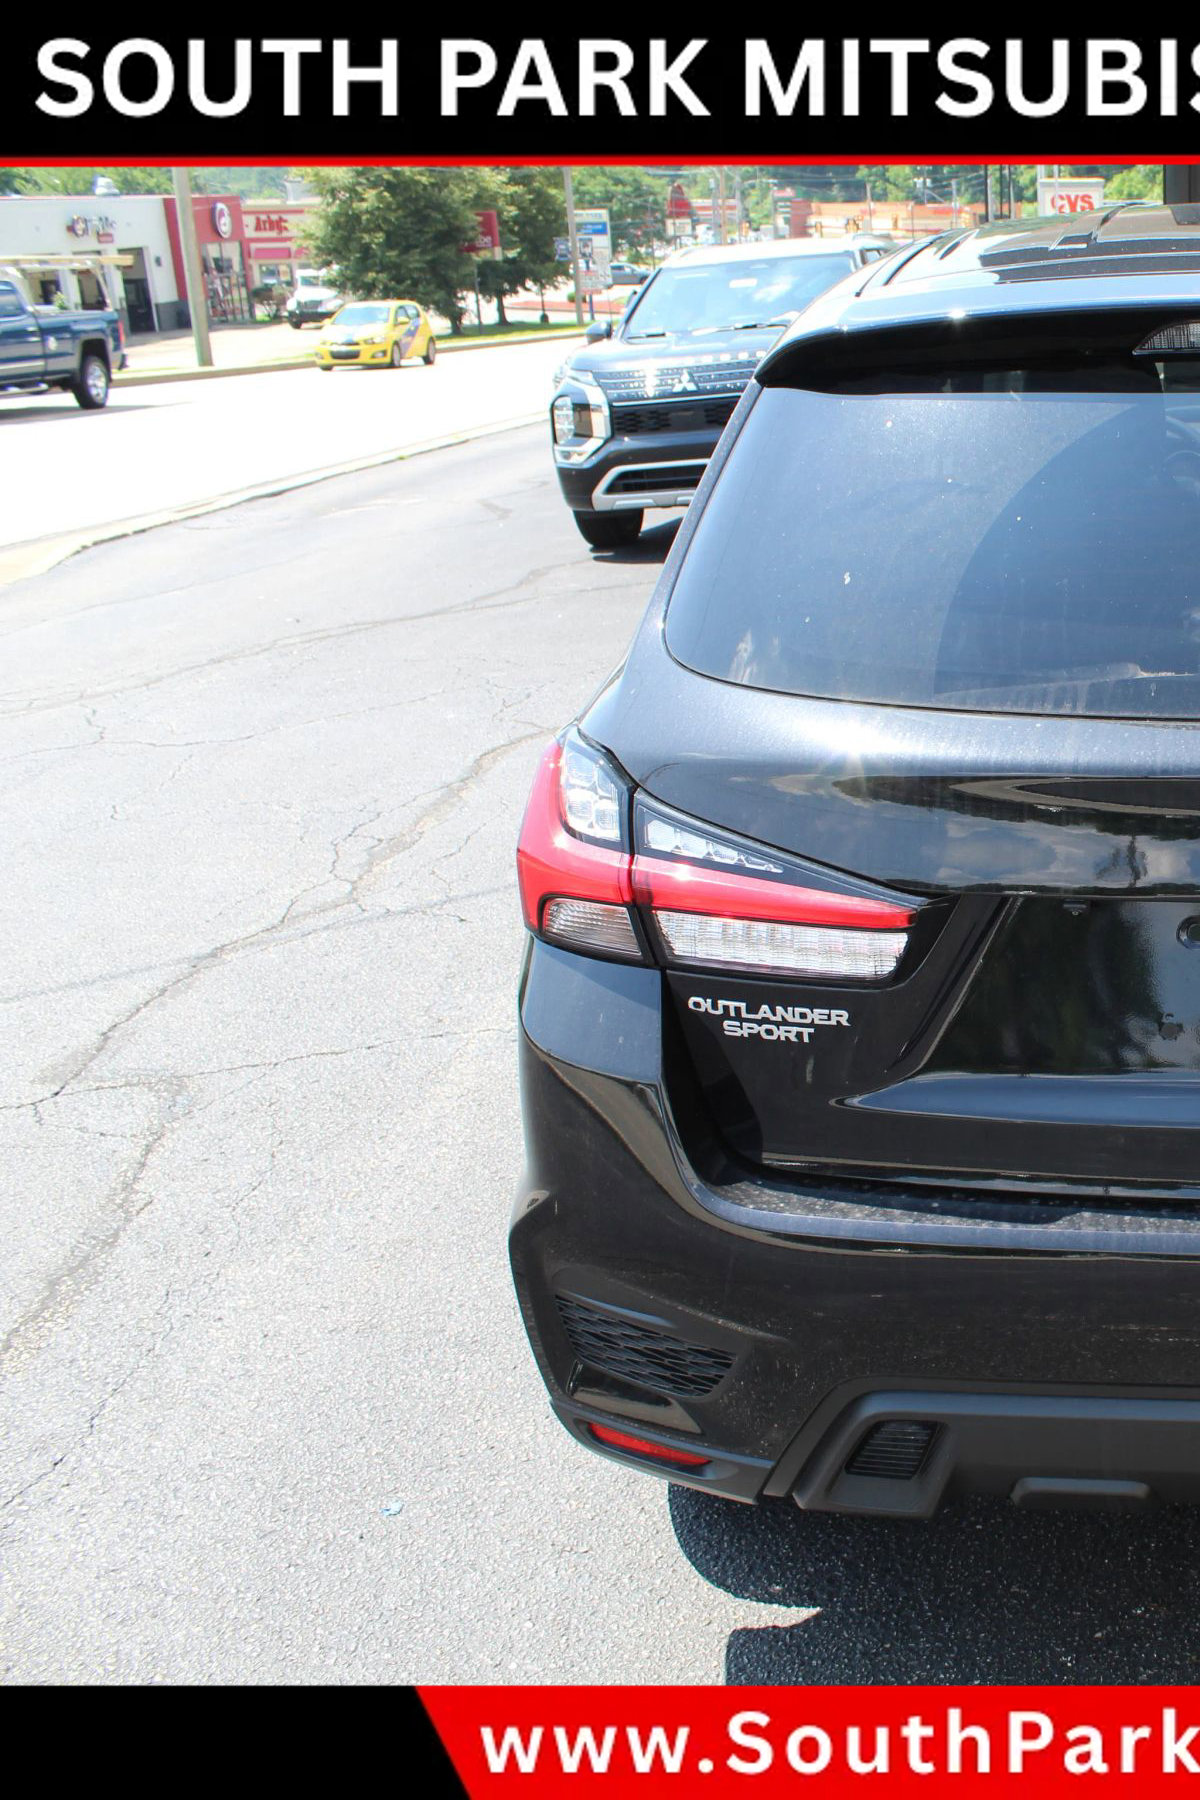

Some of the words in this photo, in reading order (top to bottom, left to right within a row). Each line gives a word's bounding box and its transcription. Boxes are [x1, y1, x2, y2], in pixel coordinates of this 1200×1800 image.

[1051, 193, 1095, 213] CVS
[687, 996, 851, 1027] OUTLANDER
[722, 1019, 815, 1043] SPORT
